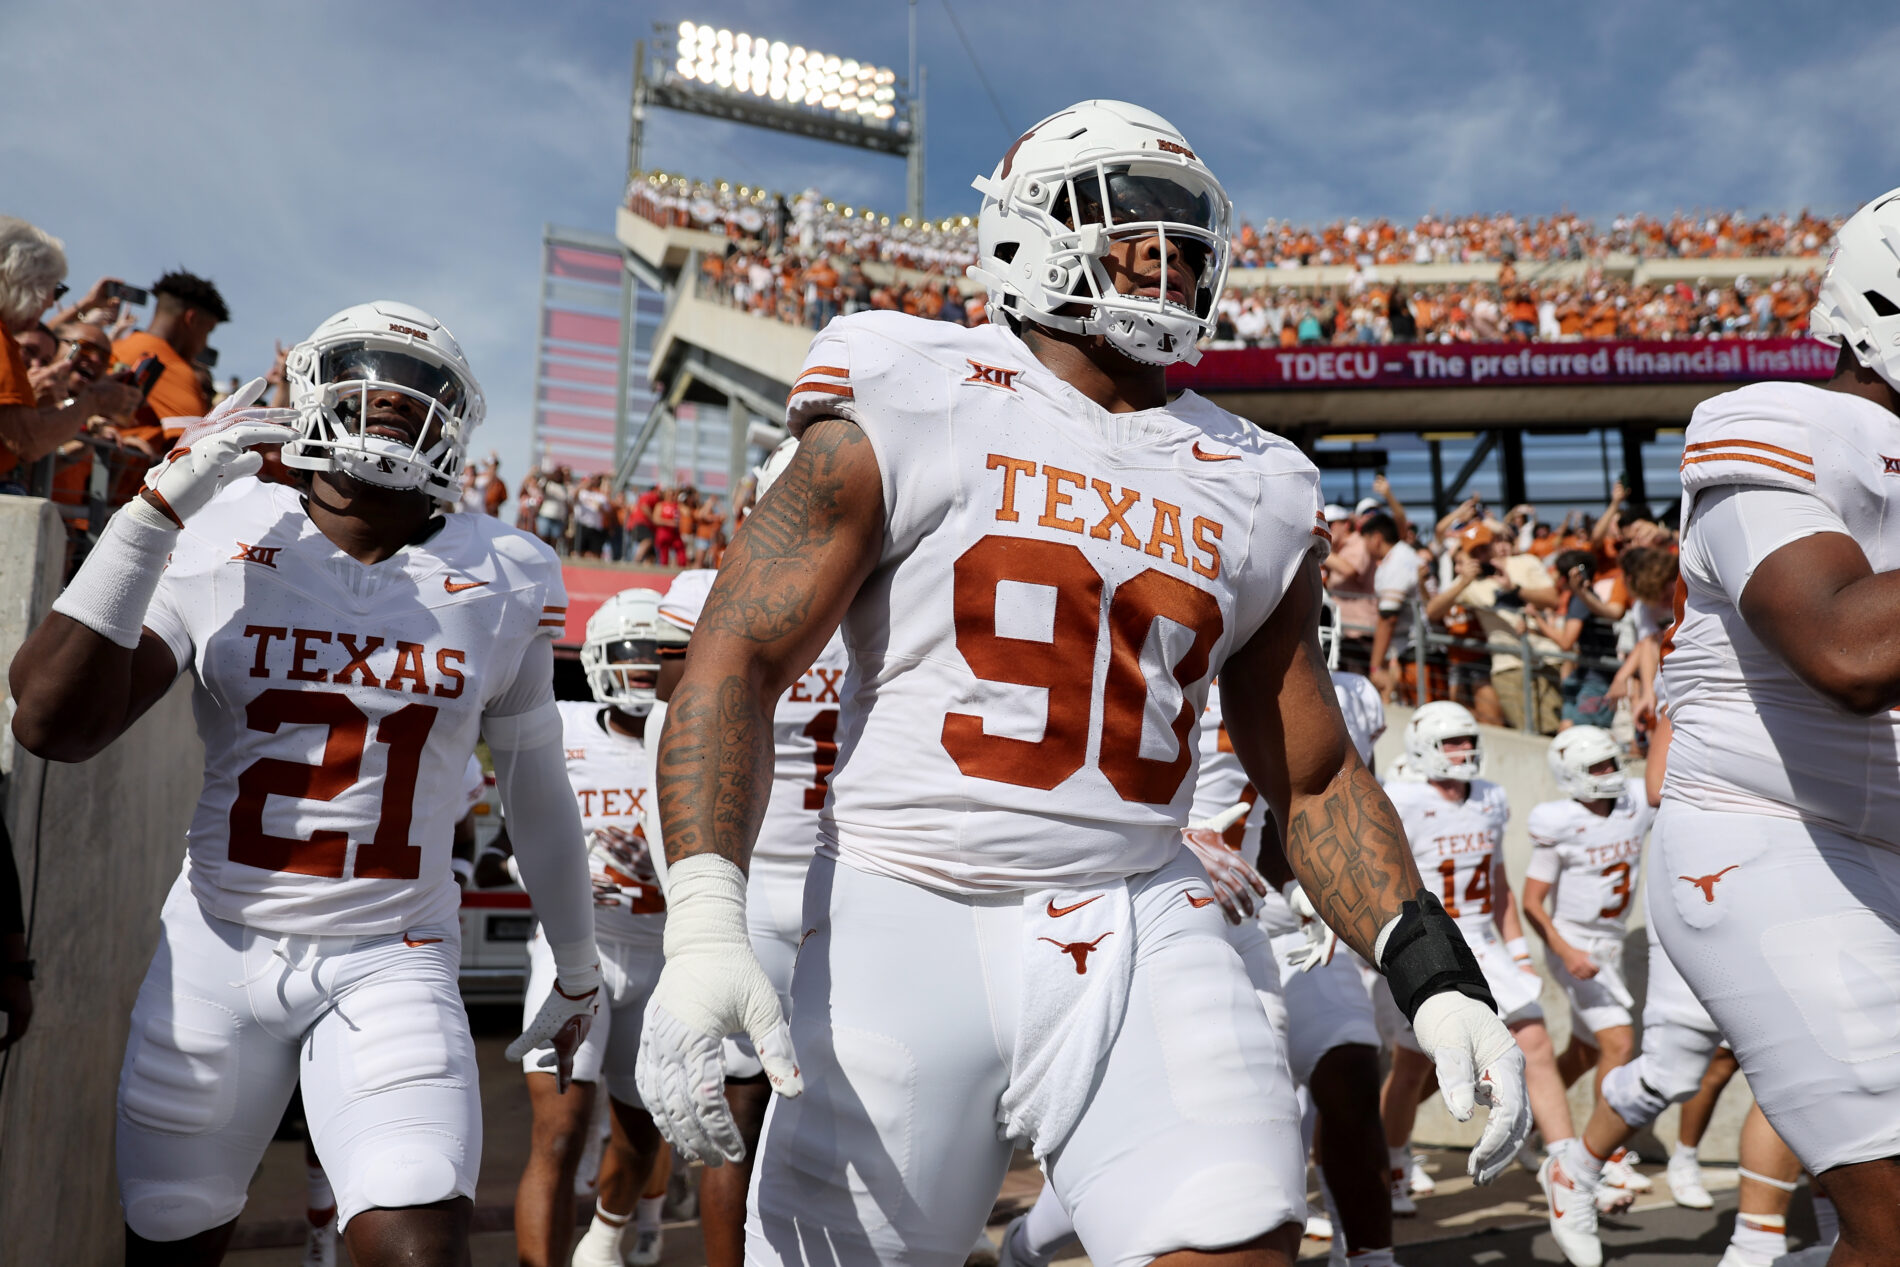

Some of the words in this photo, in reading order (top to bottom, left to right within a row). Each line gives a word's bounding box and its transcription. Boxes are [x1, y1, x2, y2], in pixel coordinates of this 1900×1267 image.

[1275, 352, 1378, 381] TDECU
[1407, 350, 1466, 379] The
[1470, 348, 1609, 382] preferred
[1614, 346, 1742, 375] financial
[986, 453, 1224, 580] TEXAS
[244, 625, 466, 699] TEXAS
[940, 534, 1225, 805] 90
[228, 688, 439, 880] 21
[1433, 830, 1495, 856] TEXAS
[1437, 853, 1493, 919] 14
[1601, 861, 1631, 918] 3
